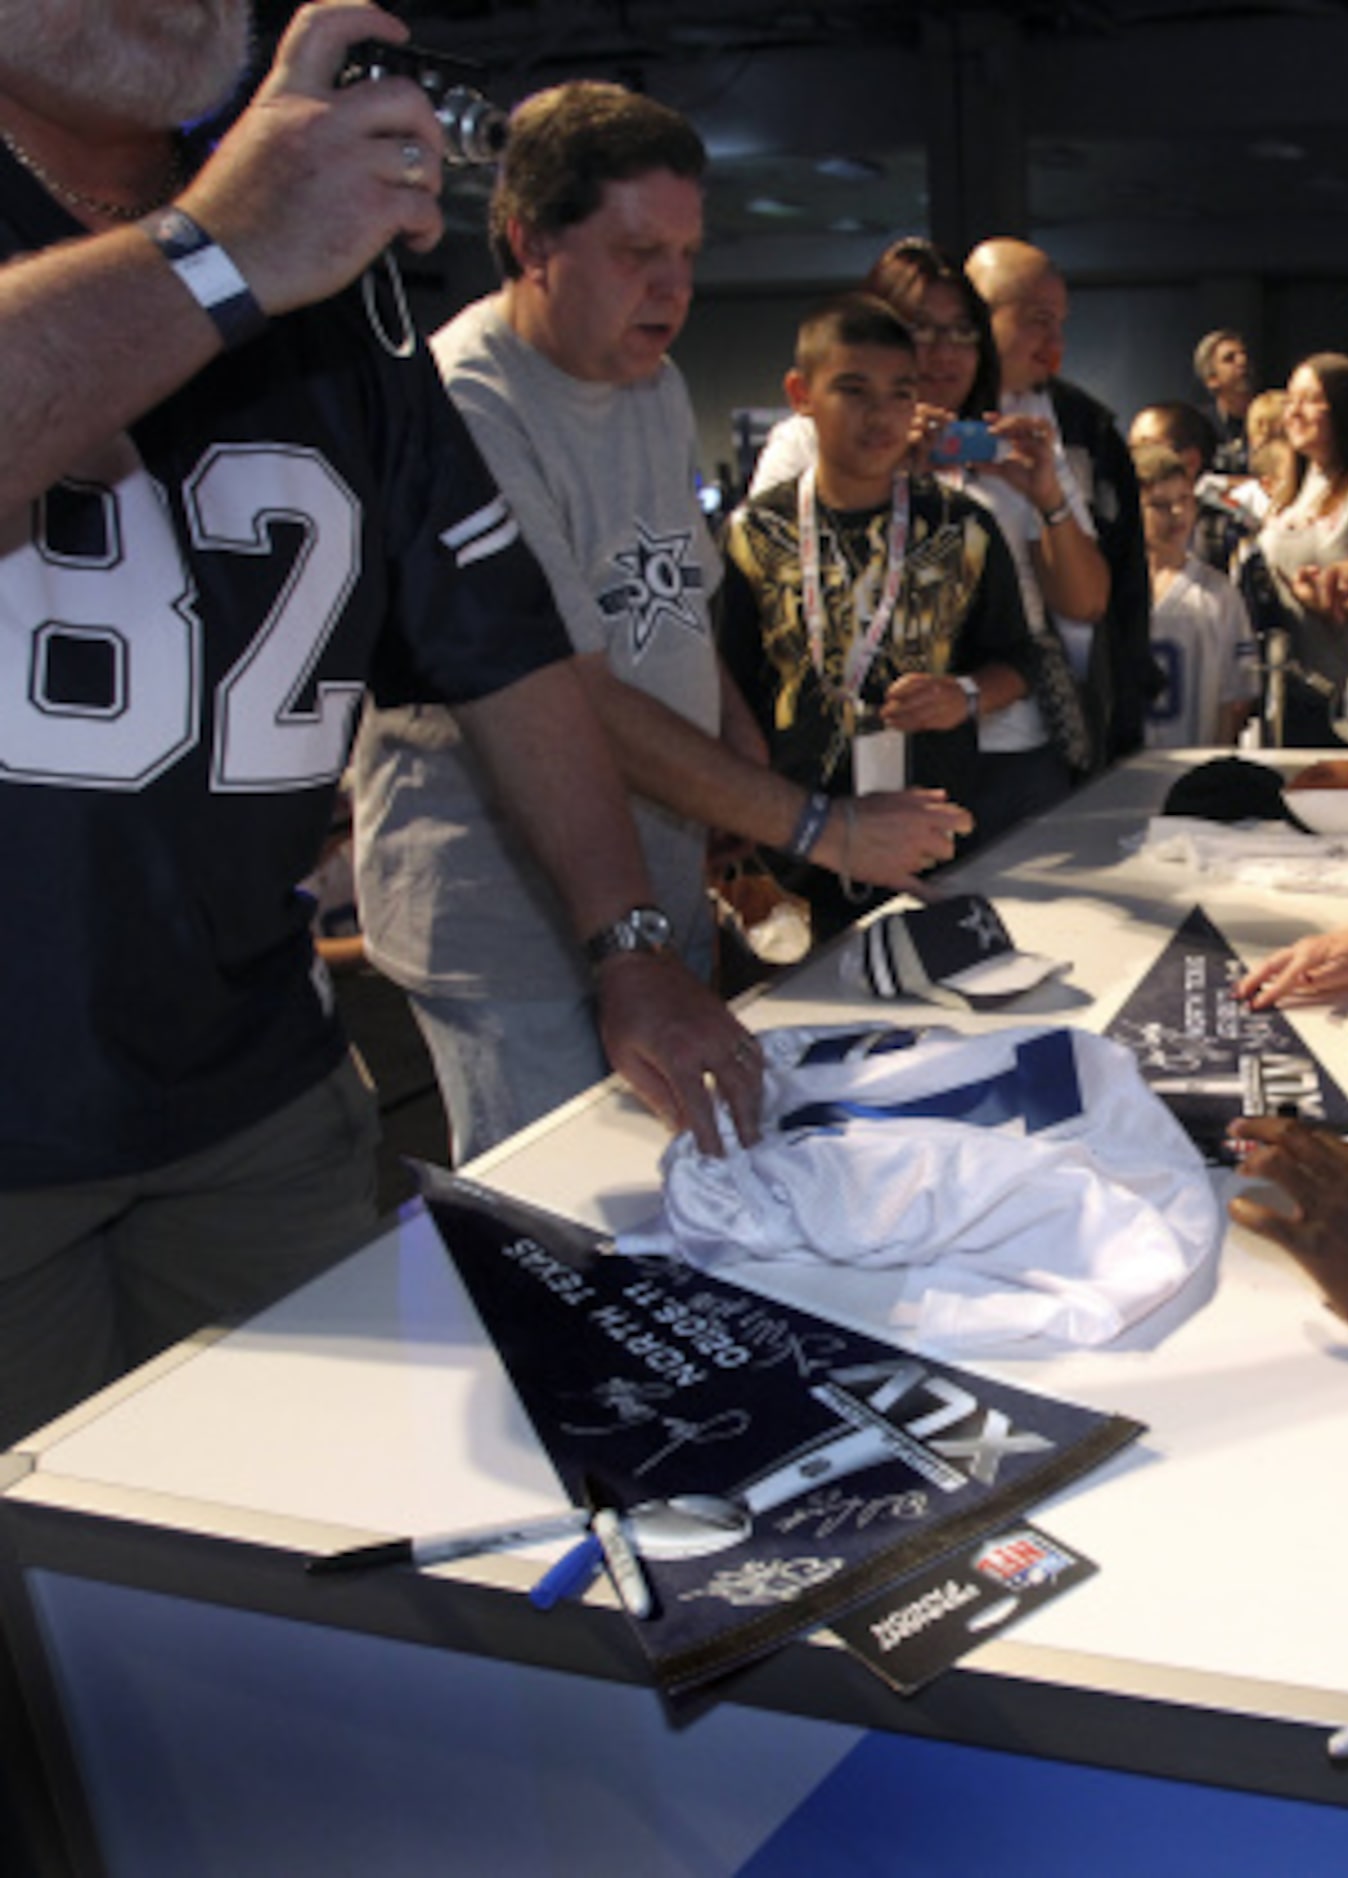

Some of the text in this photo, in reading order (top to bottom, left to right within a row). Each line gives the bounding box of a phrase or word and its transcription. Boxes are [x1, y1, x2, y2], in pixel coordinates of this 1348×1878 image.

[0, 441, 368, 793] 82
[501, 1237, 596, 1306] TEXAS
[590, 1305, 708, 1387] NORTH
[826, 1361, 1058, 1487] XLV
[975, 1539, 1049, 1579] NFL
